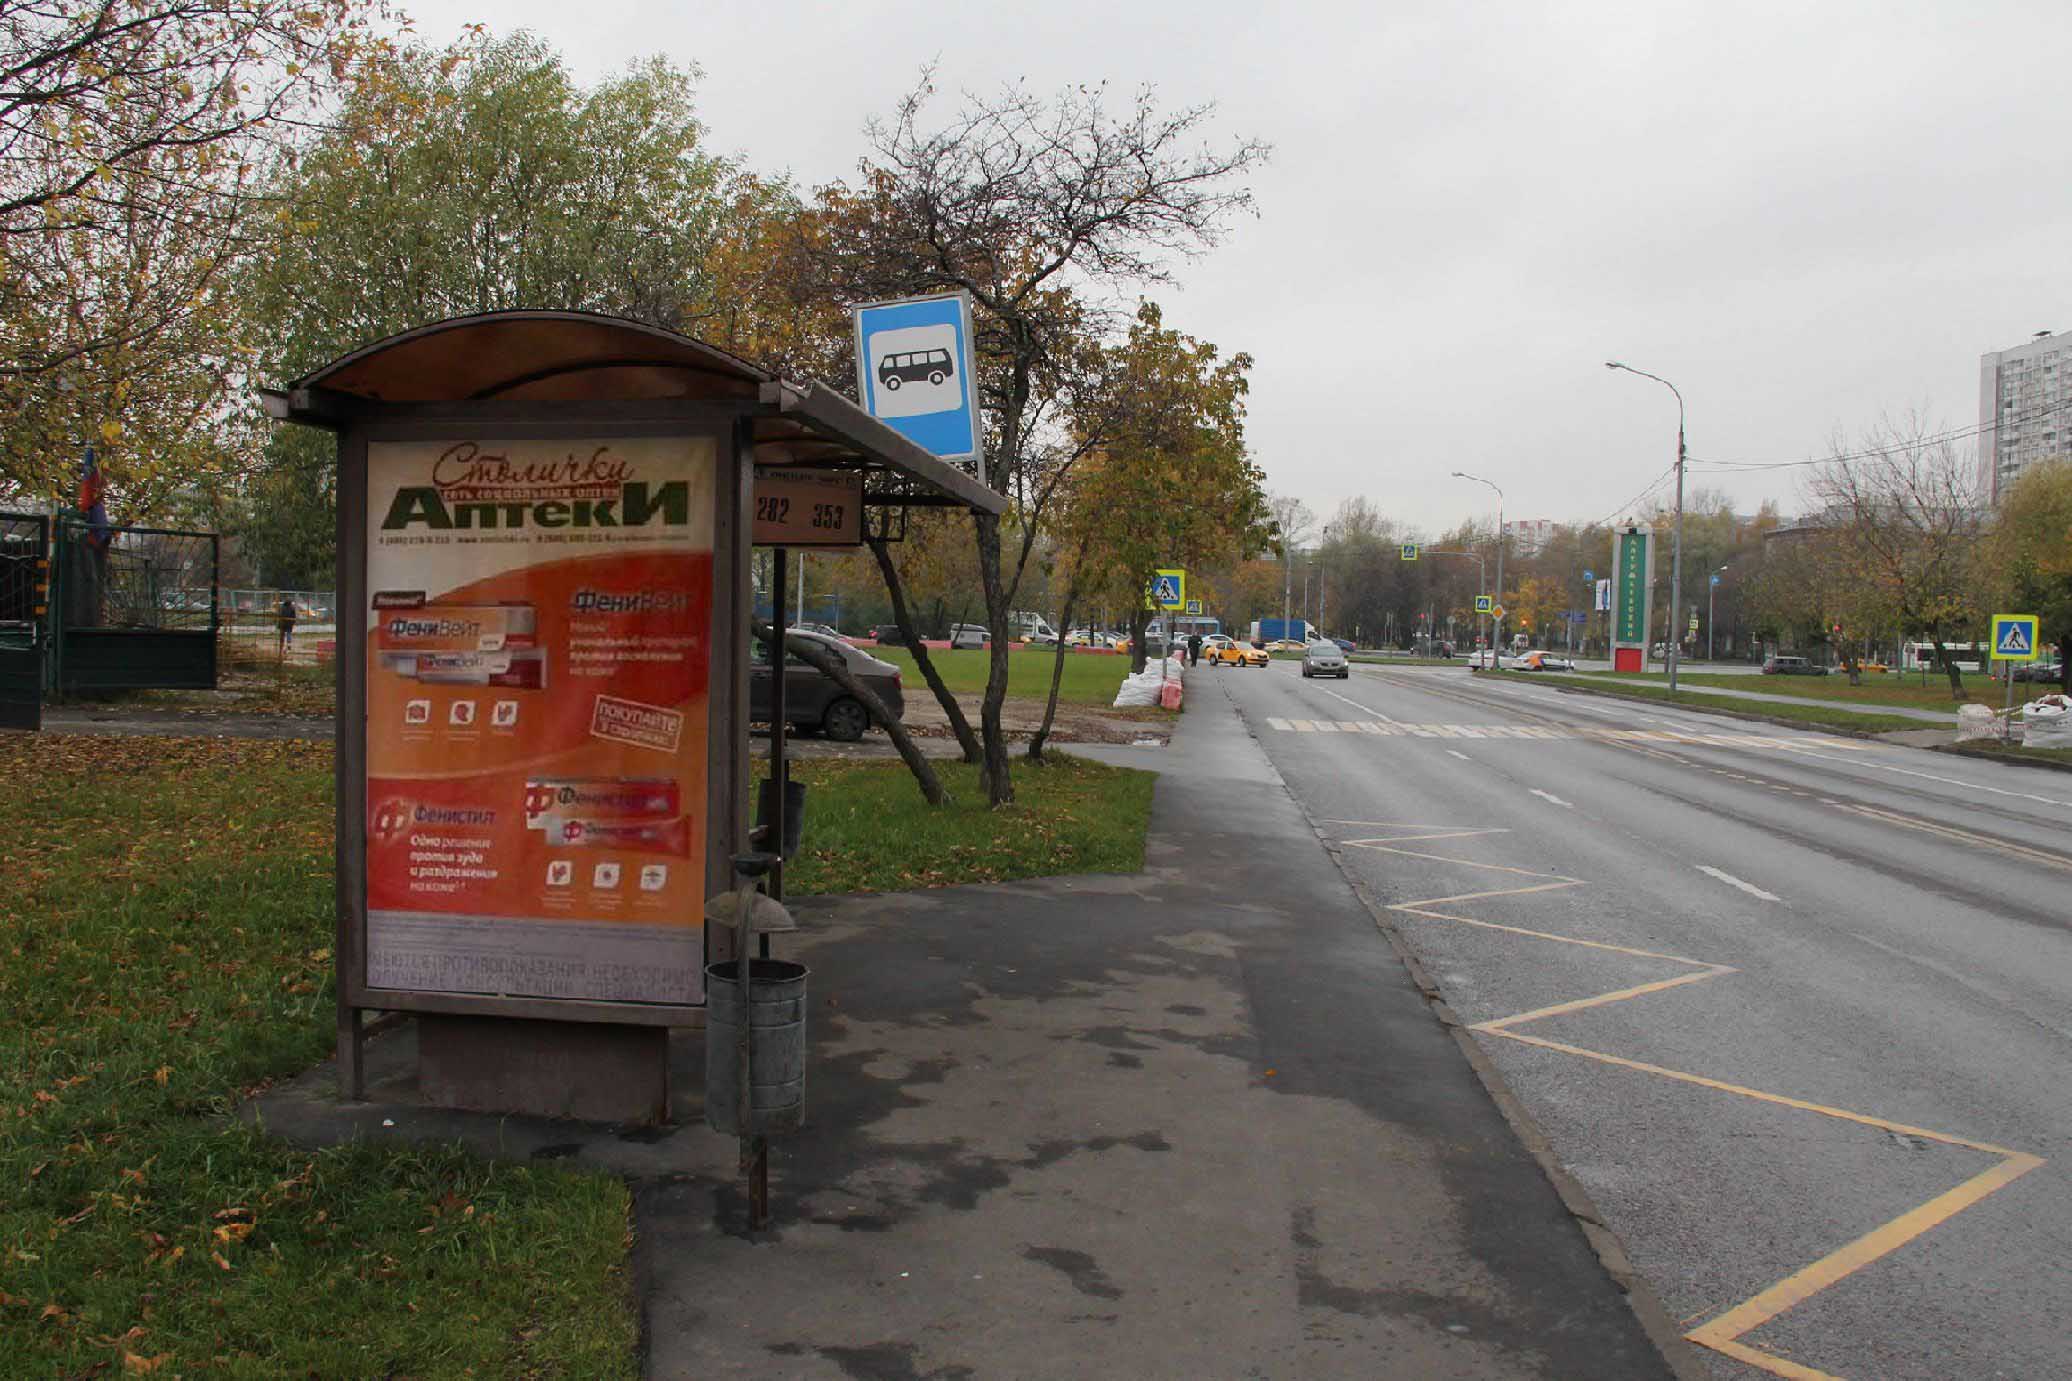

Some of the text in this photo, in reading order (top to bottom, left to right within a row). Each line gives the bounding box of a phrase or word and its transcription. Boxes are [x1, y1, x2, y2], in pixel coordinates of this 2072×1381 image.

[432, 441, 635, 487] Столички
[756, 496, 846, 531] 282 353
[413, 803, 496, 826] Фенистил
[409, 834, 441, 848] Одно
[457, 850, 484, 866] зуда
